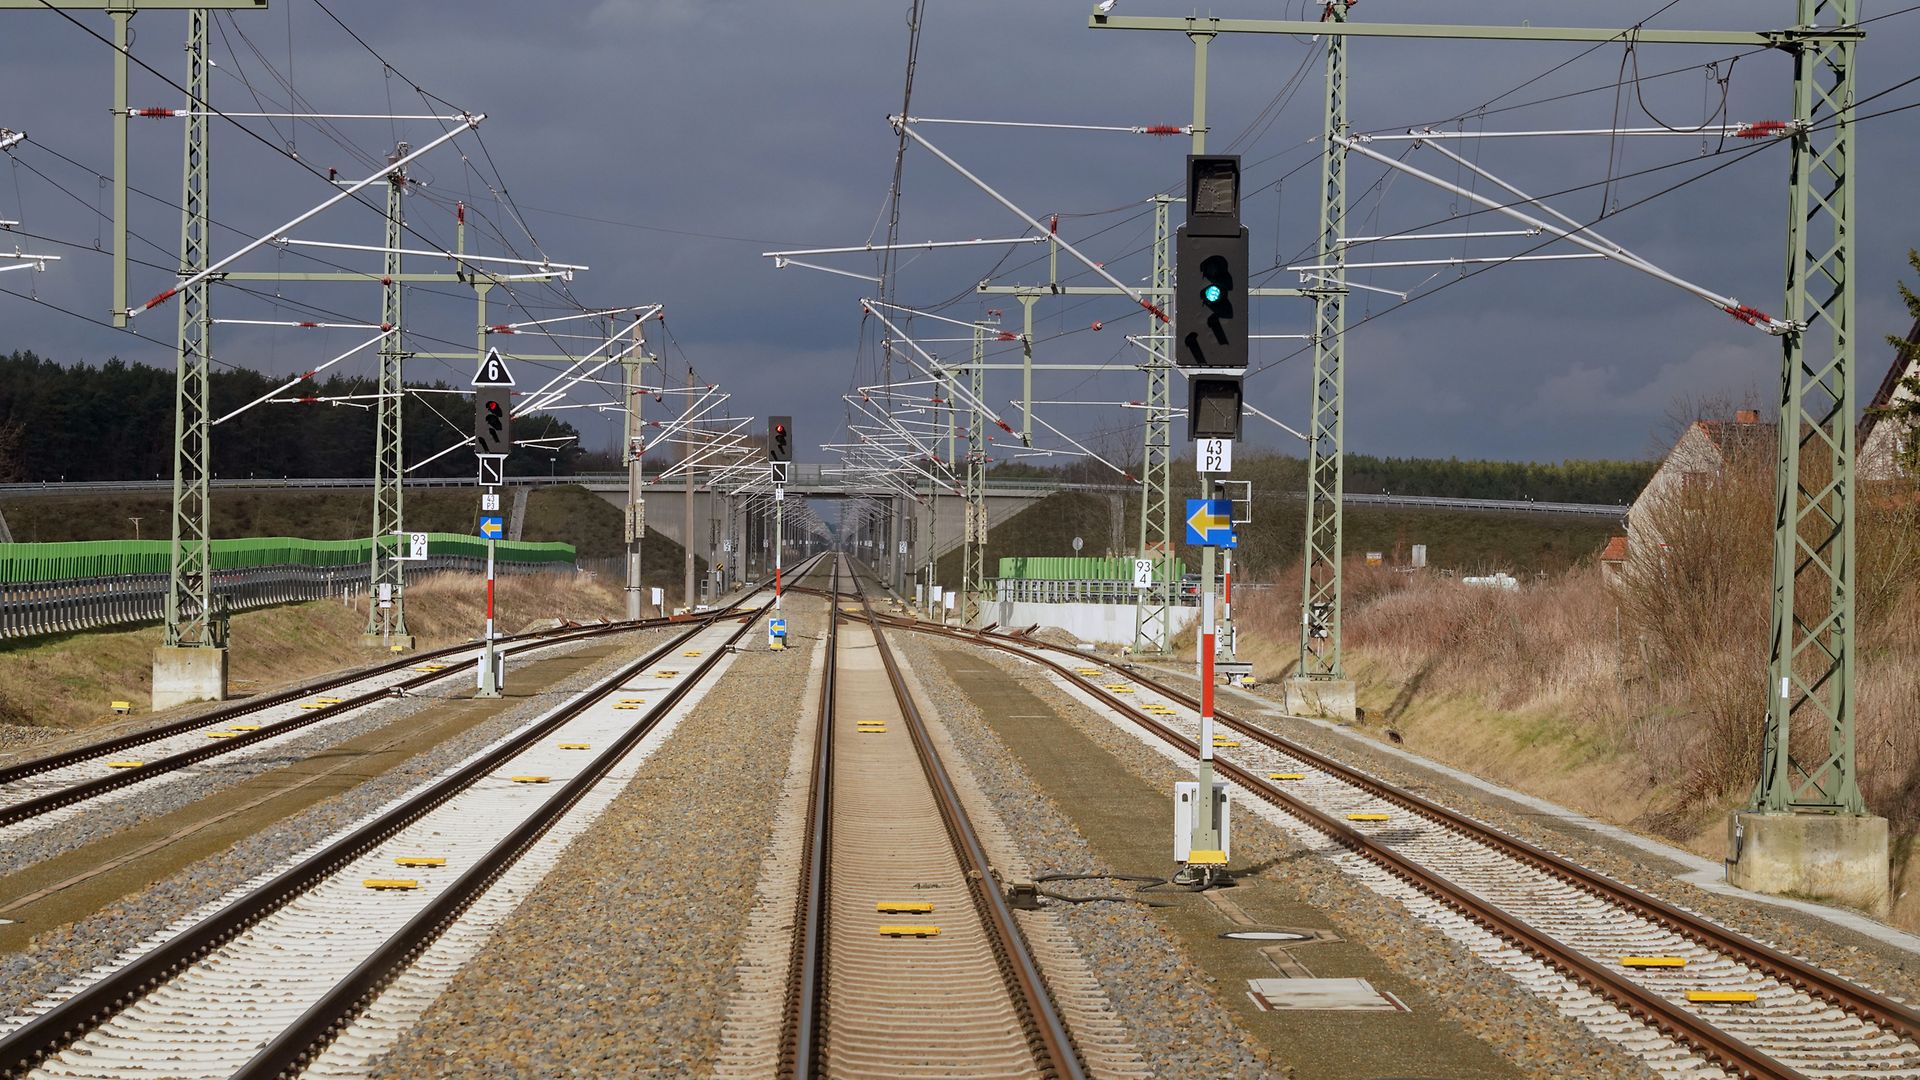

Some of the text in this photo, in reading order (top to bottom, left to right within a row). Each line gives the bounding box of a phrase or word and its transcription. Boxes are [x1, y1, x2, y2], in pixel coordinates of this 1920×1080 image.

[488, 360, 499, 381] 6
[1206, 440, 1222, 455] 43
[1206, 456, 1222, 470] P2
[412, 534, 426, 545] 93
[416, 546, 422, 556] 4
[1137, 561, 1151, 572] 93
[1140, 574, 1146, 584] 4
